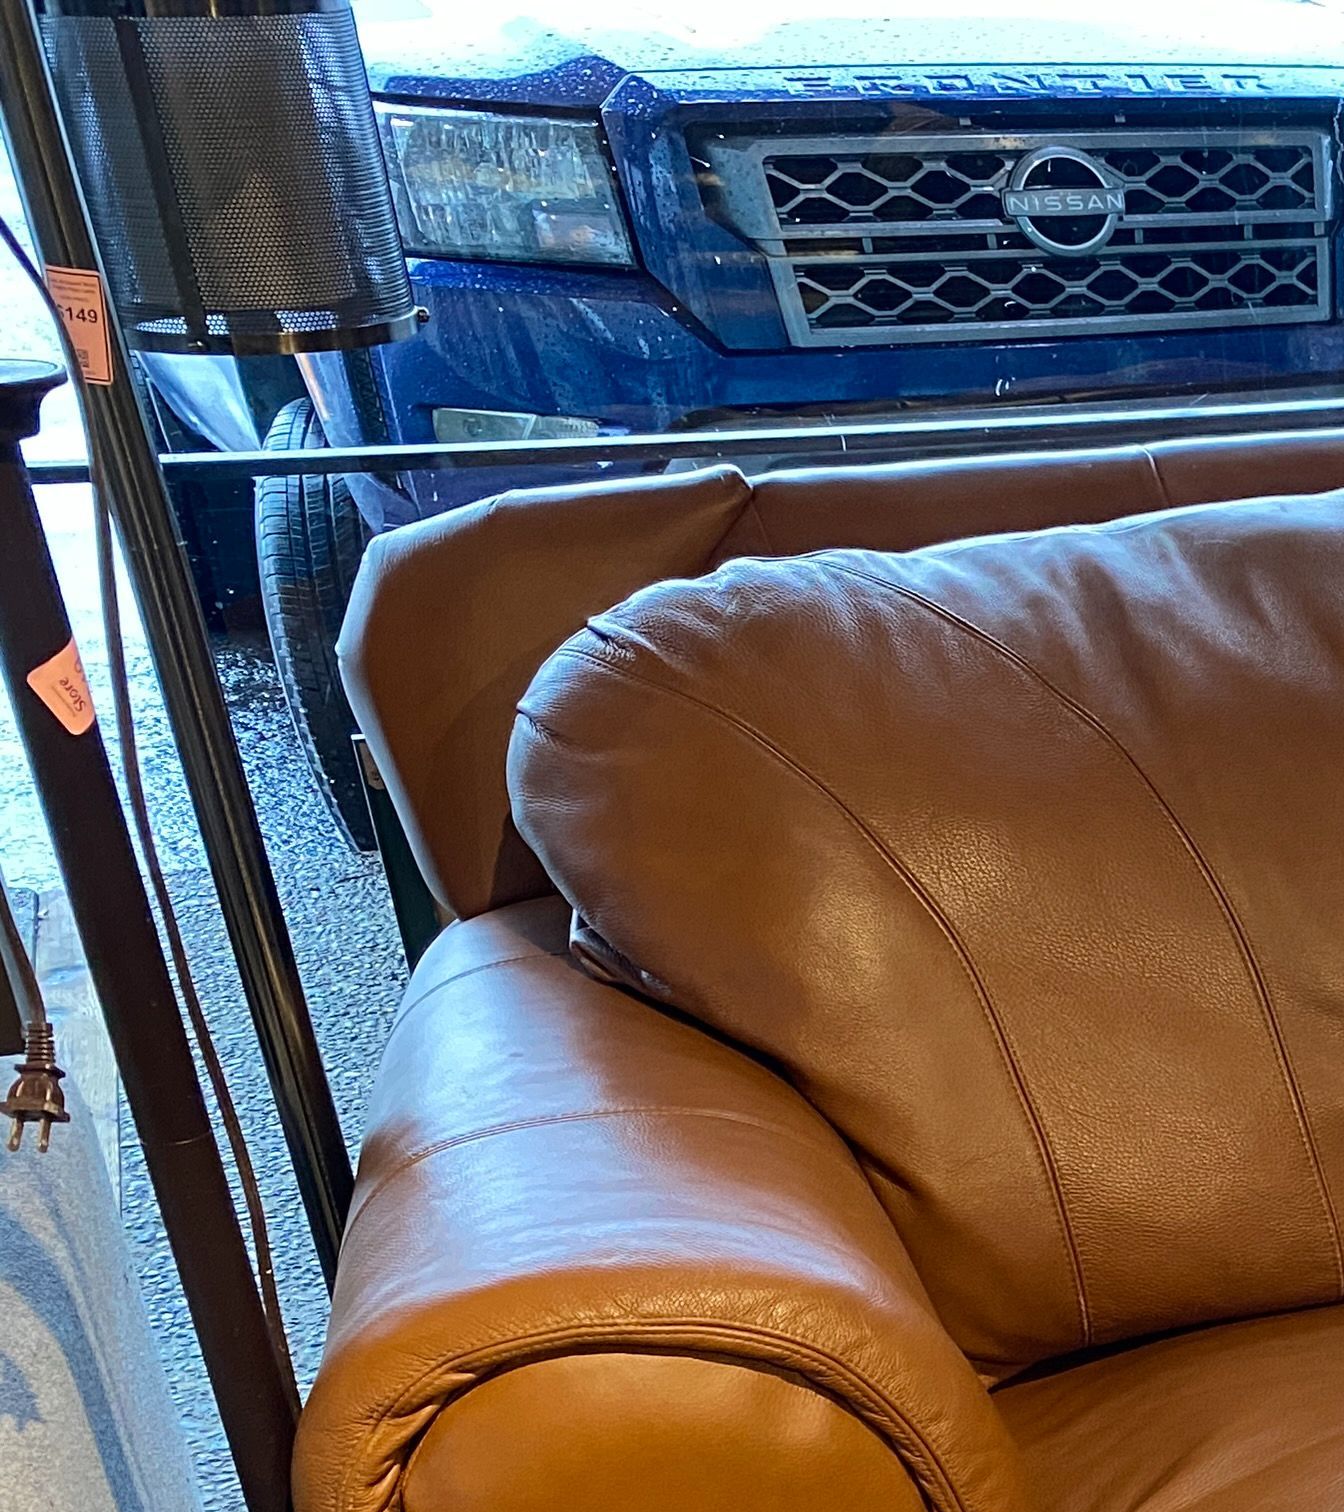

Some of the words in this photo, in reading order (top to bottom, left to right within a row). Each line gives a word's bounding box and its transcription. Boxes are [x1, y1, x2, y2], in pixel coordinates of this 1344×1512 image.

[783, 73, 1273, 95] FRONTIER
[1009, 193, 1123, 211] NISSAN
[60, 677, 86, 712] Store
